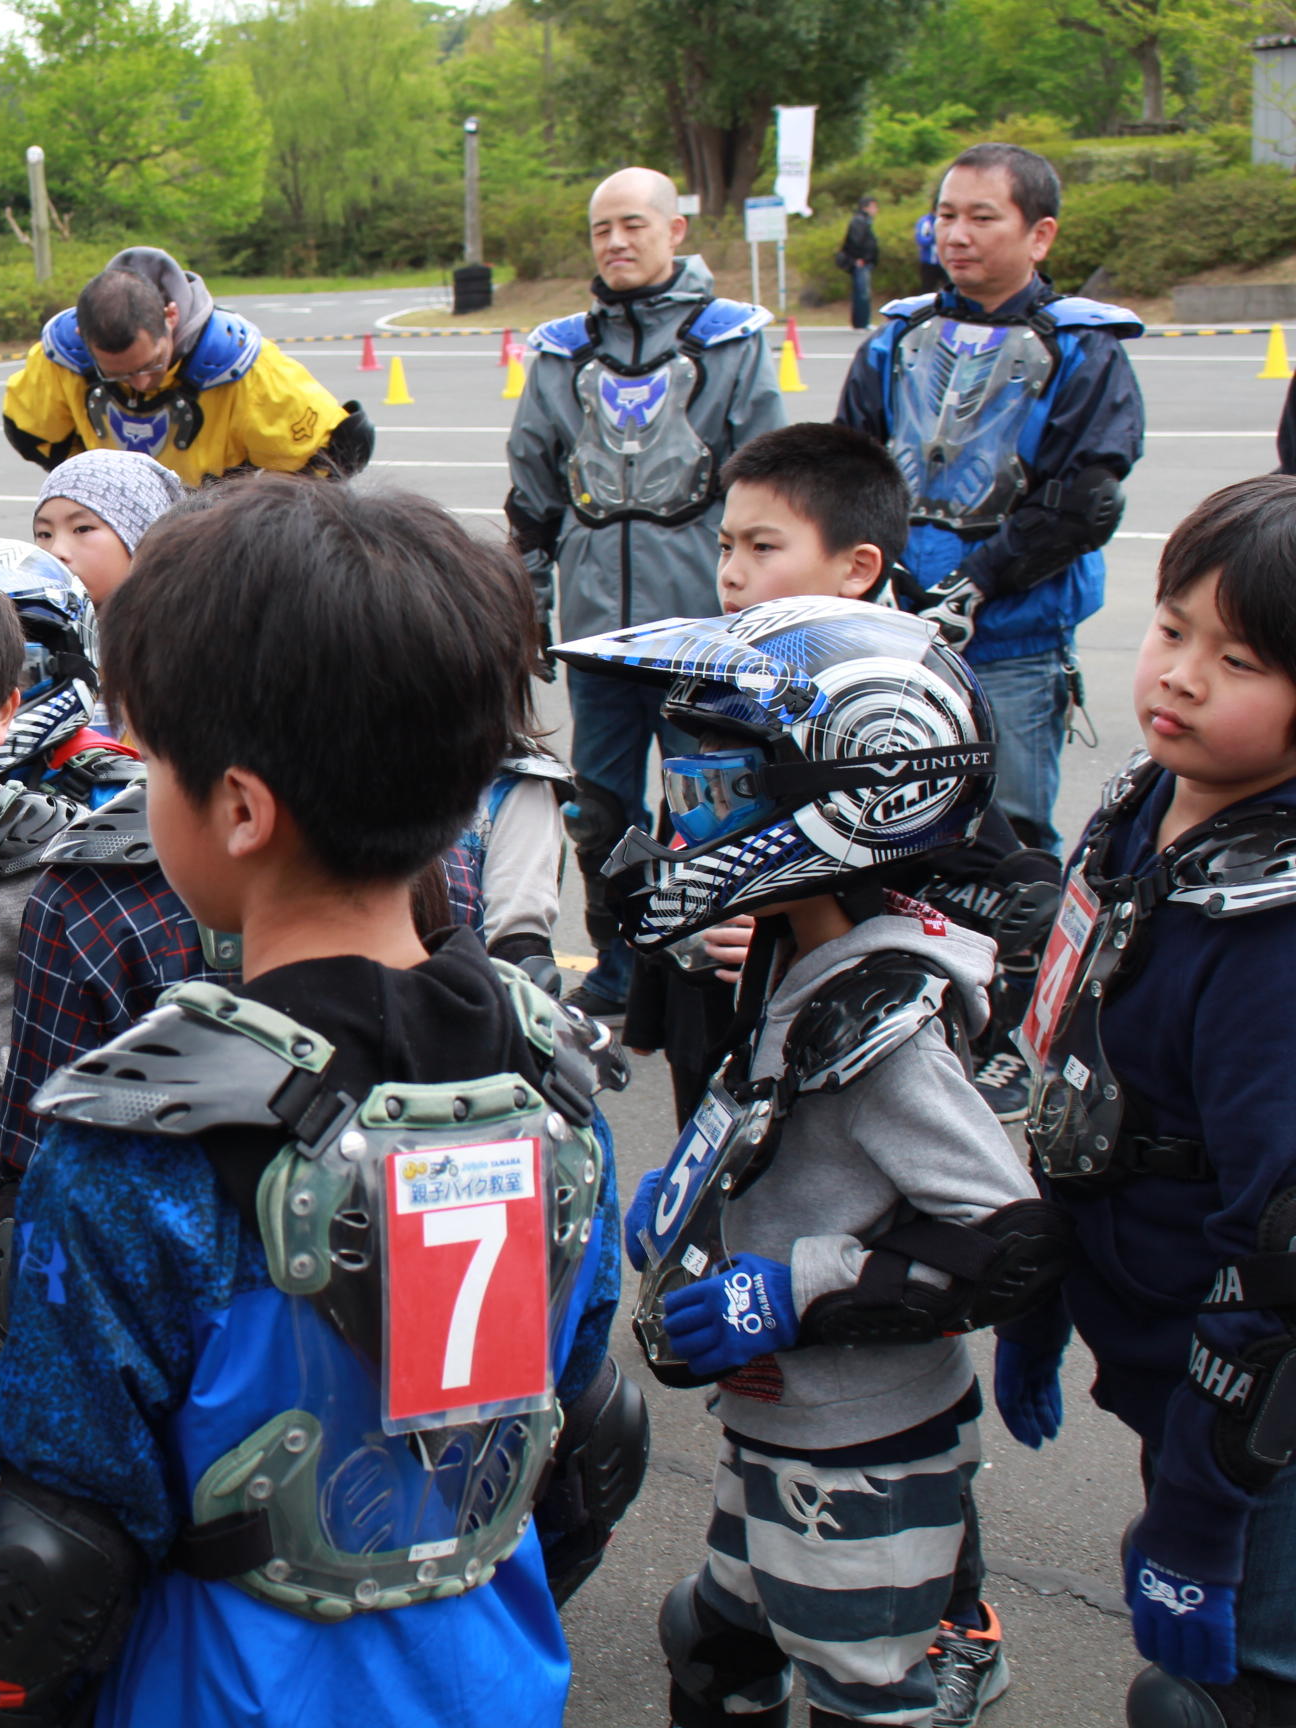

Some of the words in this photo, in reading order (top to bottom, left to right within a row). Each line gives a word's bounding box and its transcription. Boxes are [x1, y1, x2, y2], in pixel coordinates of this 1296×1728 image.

[911, 751, 990, 772] UNIVET
[872, 776, 958, 826] HJC
[1034, 943, 1074, 1052] 4
[410, 1172, 523, 1206] 親子バイク教室
[655, 1131, 710, 1237] 5
[423, 1203, 508, 1390] 7
[753, 1272, 774, 1317] YAMAHA
